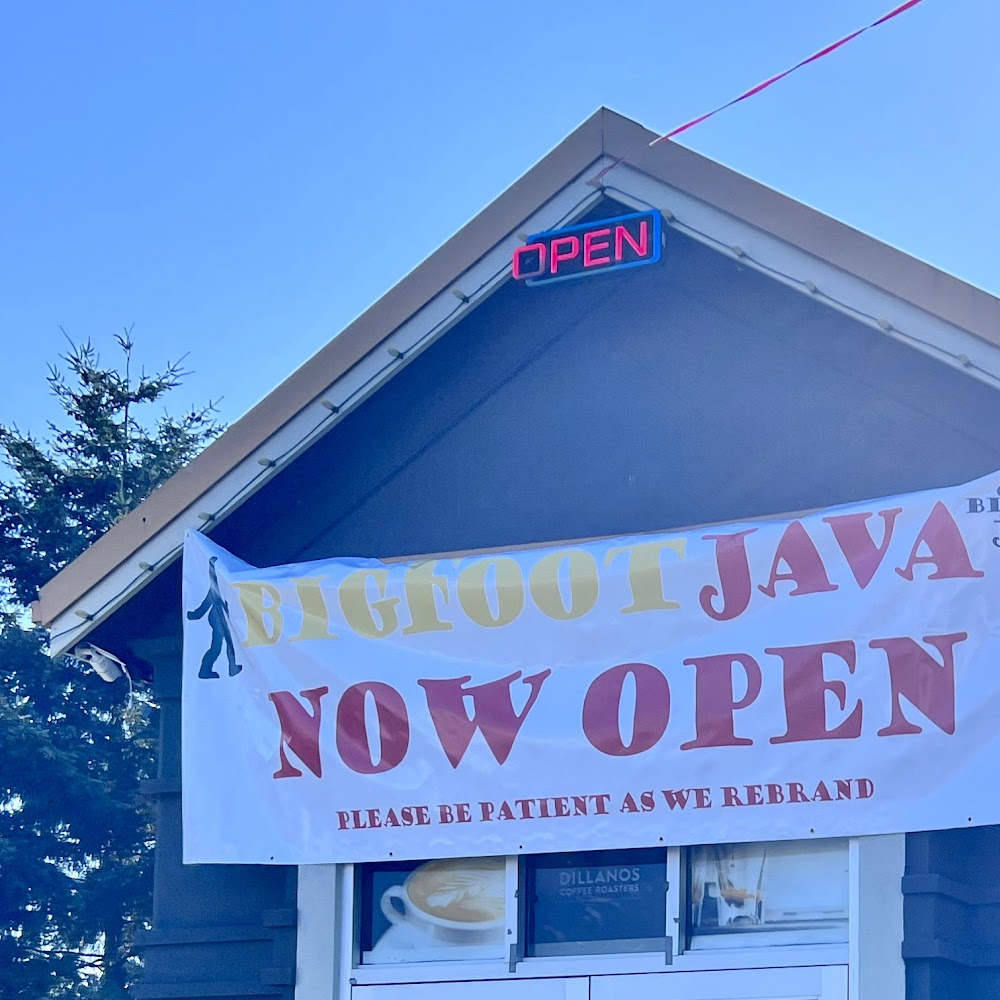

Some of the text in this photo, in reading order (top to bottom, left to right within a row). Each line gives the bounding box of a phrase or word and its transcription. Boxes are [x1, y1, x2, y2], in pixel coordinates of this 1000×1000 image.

[512, 221, 647, 280] OPEN
[230, 501, 985, 648] BIGFOOT JAVA
[268, 631, 968, 779] NOW OPEN
[336, 778, 874, 830] PLEASE BE PATIENT AS WE REBRAND
[560, 867, 640, 886] DILLANOS
[560, 883, 639, 896] COFFEE ROASTERS
